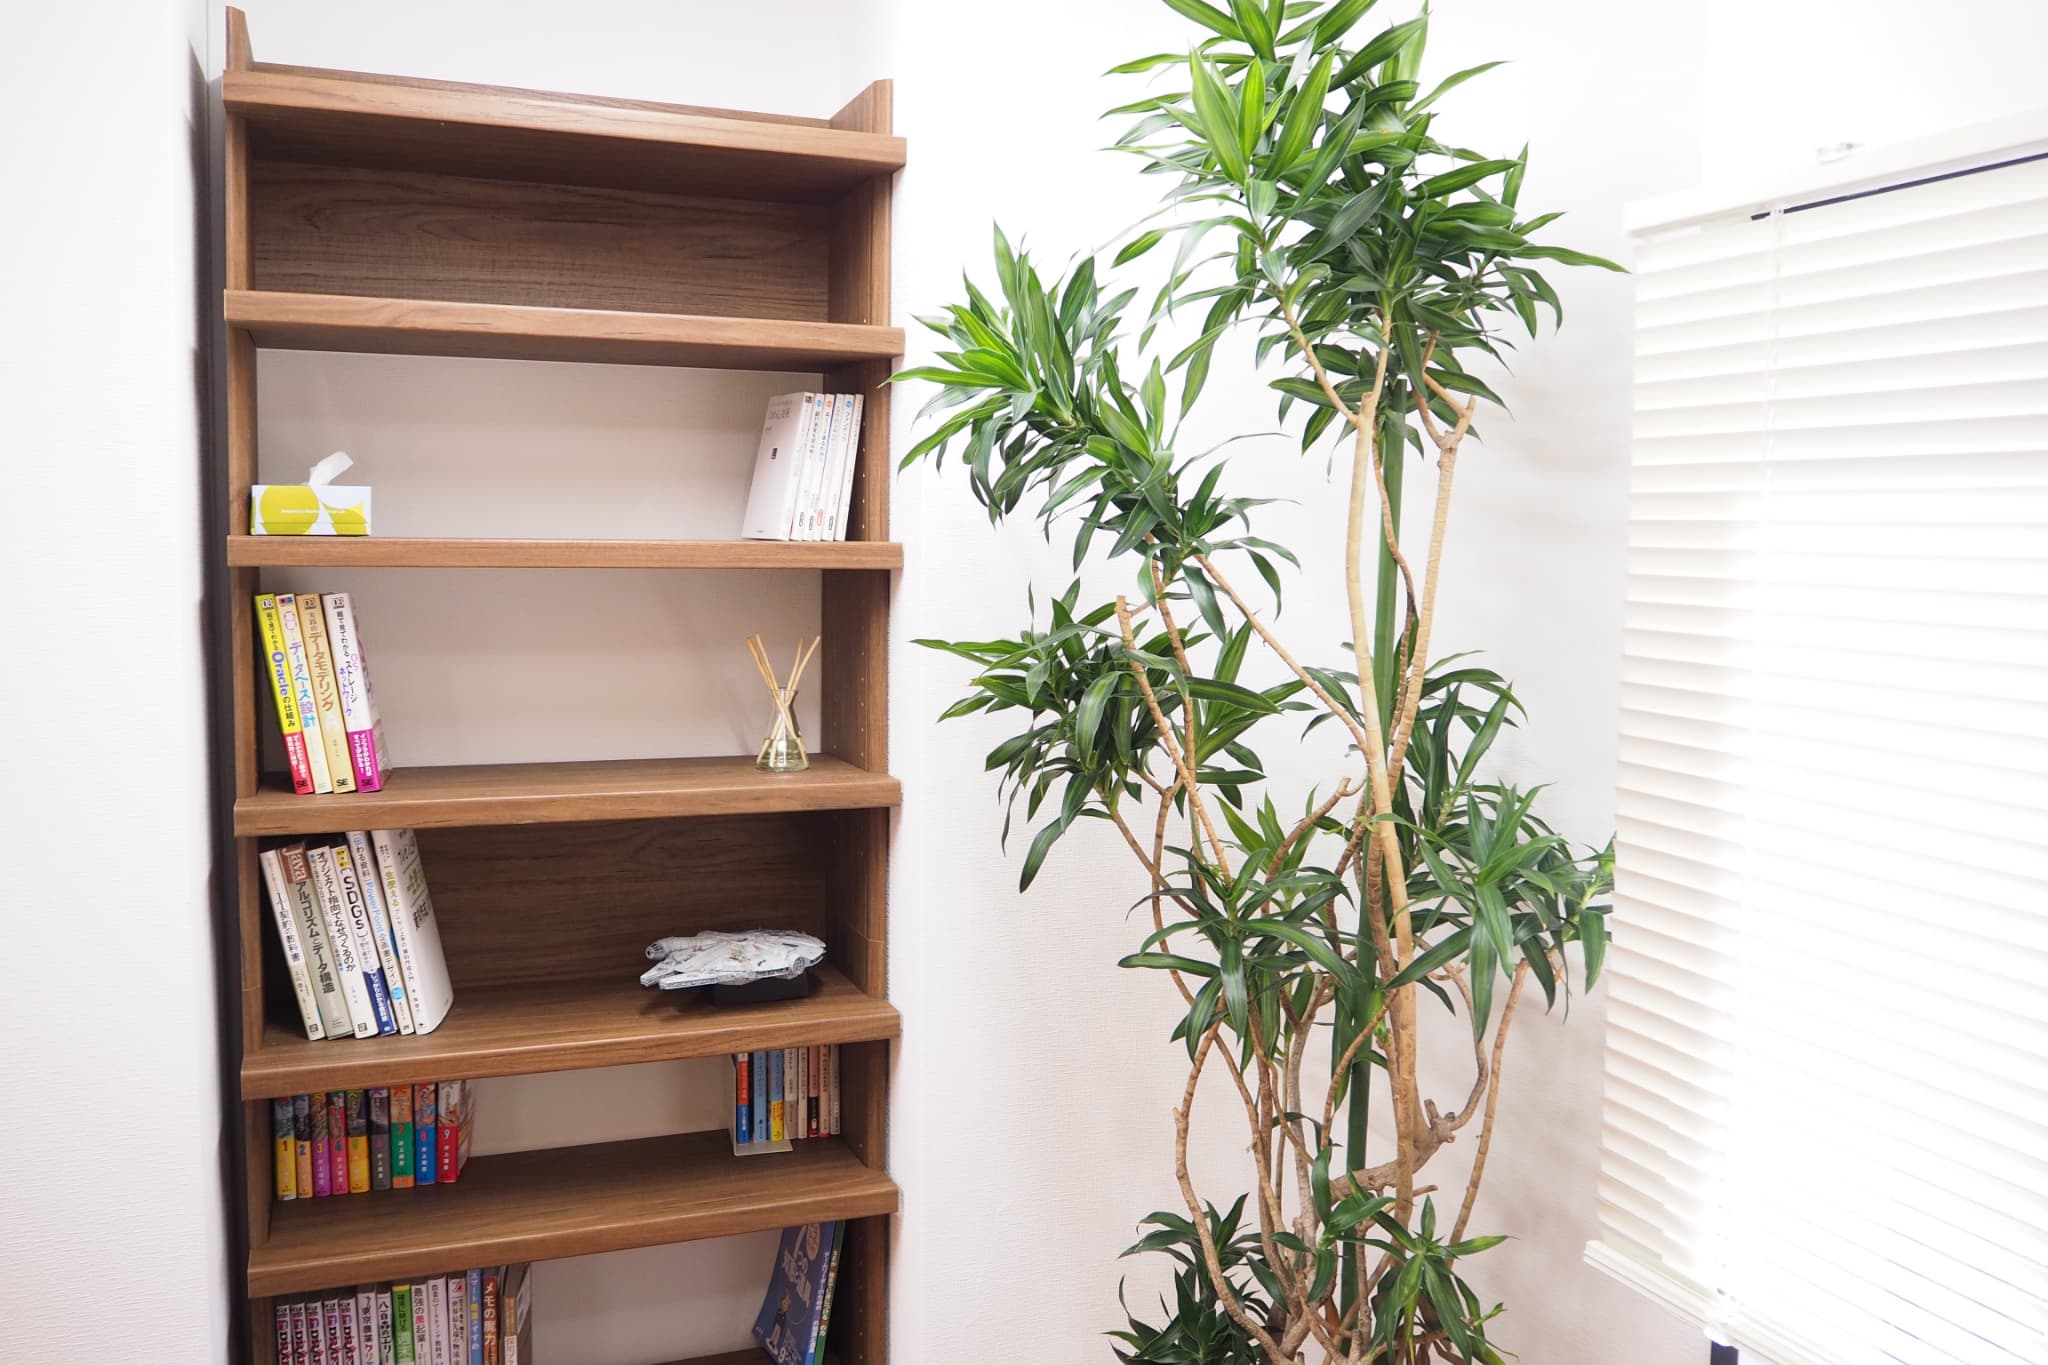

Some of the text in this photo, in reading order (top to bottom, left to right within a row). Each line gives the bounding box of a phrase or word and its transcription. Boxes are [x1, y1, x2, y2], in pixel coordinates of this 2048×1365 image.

[284, 847, 306, 882] Java
[316, 851, 354, 973] オブジェクト指向でなぜつくるのか
[444, 1129, 450, 1140] 9
[282, 1140, 288, 1152] 1
[299, 1143, 306, 1155] 2
[317, 1143, 323, 1153] 3
[379, 1301, 391, 1363] 八百森のエリー
